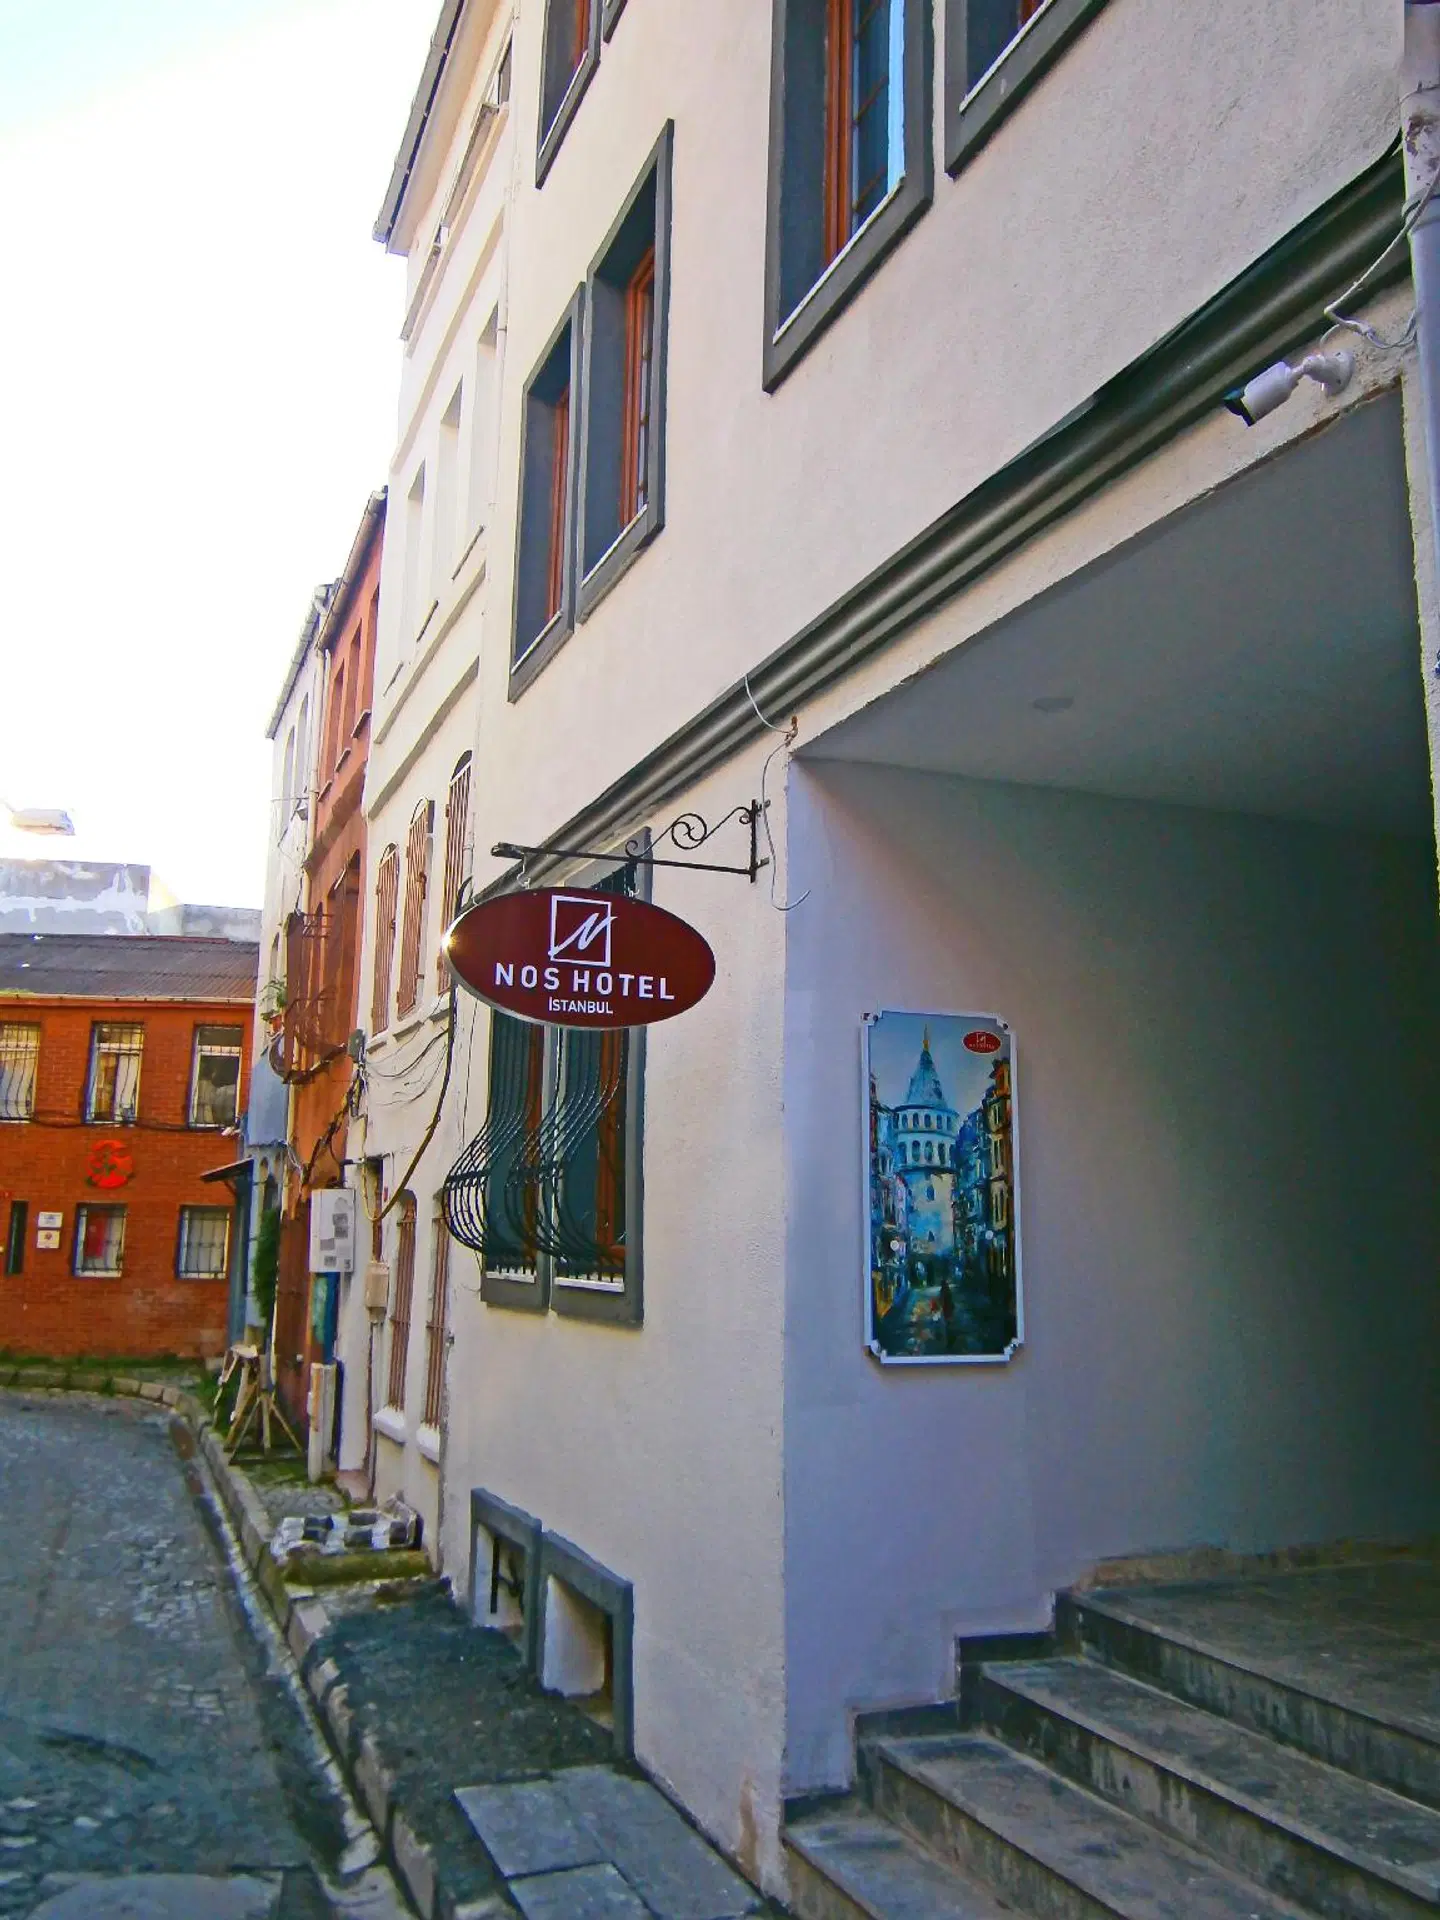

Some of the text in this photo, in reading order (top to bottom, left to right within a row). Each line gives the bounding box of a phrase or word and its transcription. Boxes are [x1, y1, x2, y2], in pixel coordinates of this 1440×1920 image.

[494, 962, 675, 1000] NOS HOTEL
[548, 996, 614, 1014] ISTANBUL
